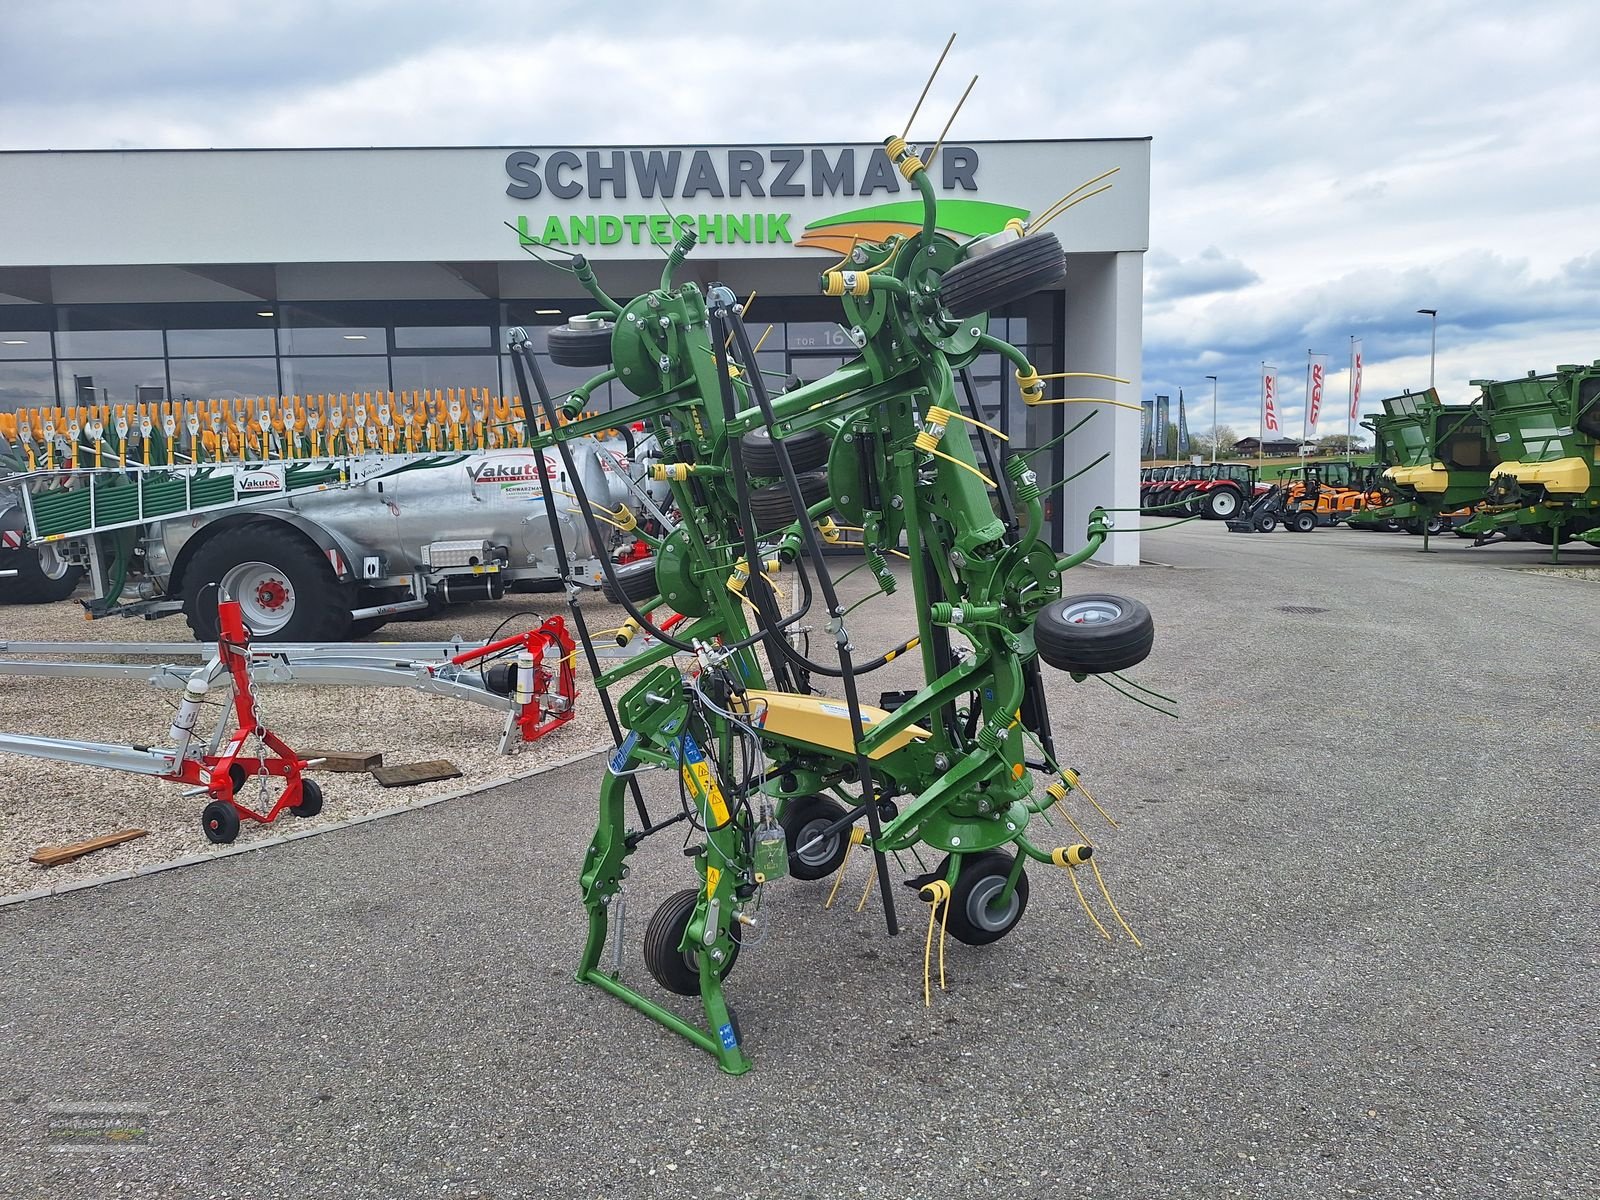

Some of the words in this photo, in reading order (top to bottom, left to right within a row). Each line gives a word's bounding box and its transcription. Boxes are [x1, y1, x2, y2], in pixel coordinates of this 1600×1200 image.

[518, 213, 793, 245] LANDTECHNIK
[796, 337, 815, 346] TOR
[823, 330, 844, 346] 16
[1265, 375, 1278, 432] STEYR
[1310, 364, 1322, 425] STEYR
[239, 477, 280, 490] Vakutec
